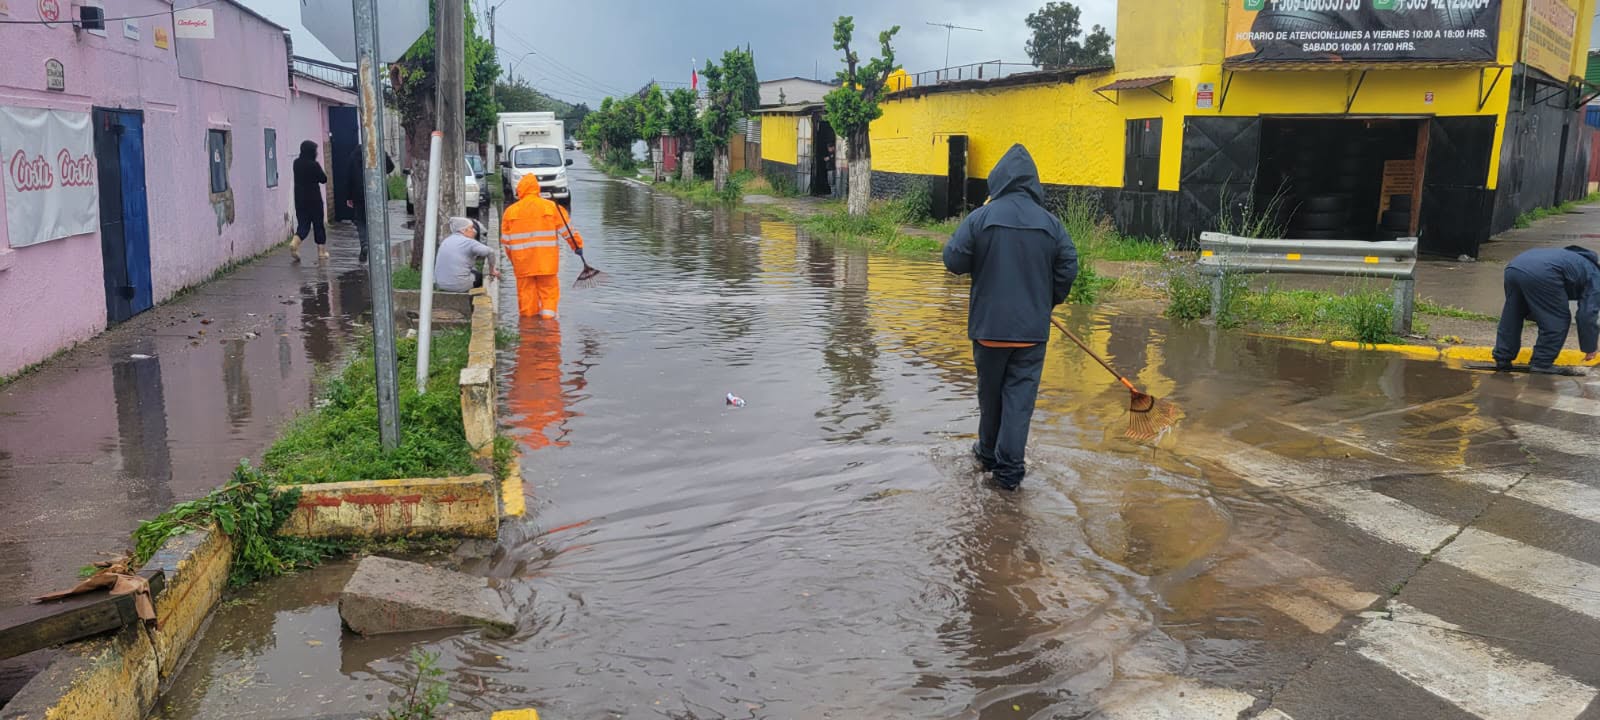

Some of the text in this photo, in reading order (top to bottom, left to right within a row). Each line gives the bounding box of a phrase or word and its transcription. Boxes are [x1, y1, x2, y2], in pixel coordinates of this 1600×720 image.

[1235, 31, 1274, 40] HORARIO
[1275, 31, 1288, 40] DE
[1363, 30, 1371, 39] A
[1373, 30, 1410, 39] VIERNES
[1412, 30, 1433, 38] 10:00
[1434, 30, 1441, 38] A
[1443, 29, 1465, 38] 18:00
[1466, 29, 1488, 38] HRS.
[1302, 42, 1416, 51] SABADO 10:00 A 17:00 HRS.
